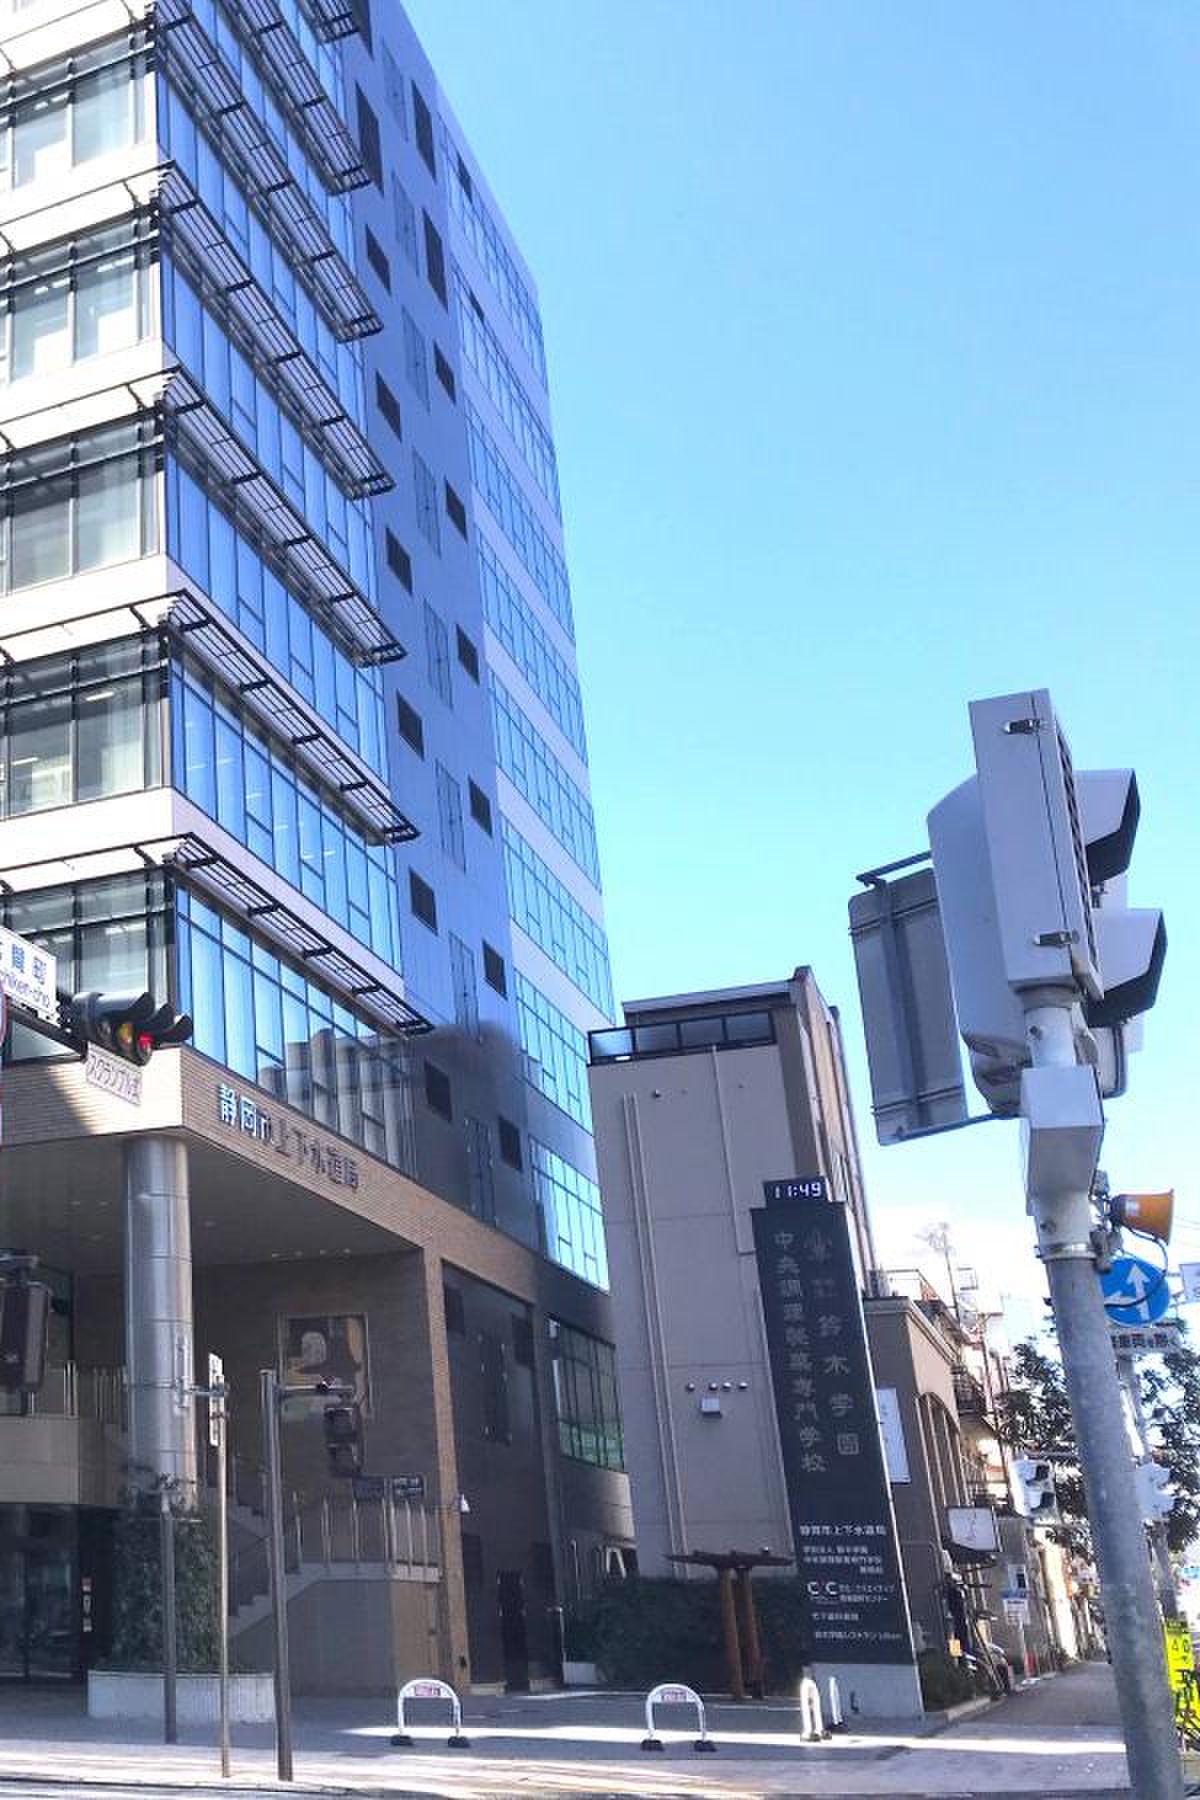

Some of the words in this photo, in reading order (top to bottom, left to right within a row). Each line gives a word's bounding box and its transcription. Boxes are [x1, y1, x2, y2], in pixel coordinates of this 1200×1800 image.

[217, 1083, 359, 1192] 静岡市上下水道局
[774, 1182, 822, 1199] 11:49
